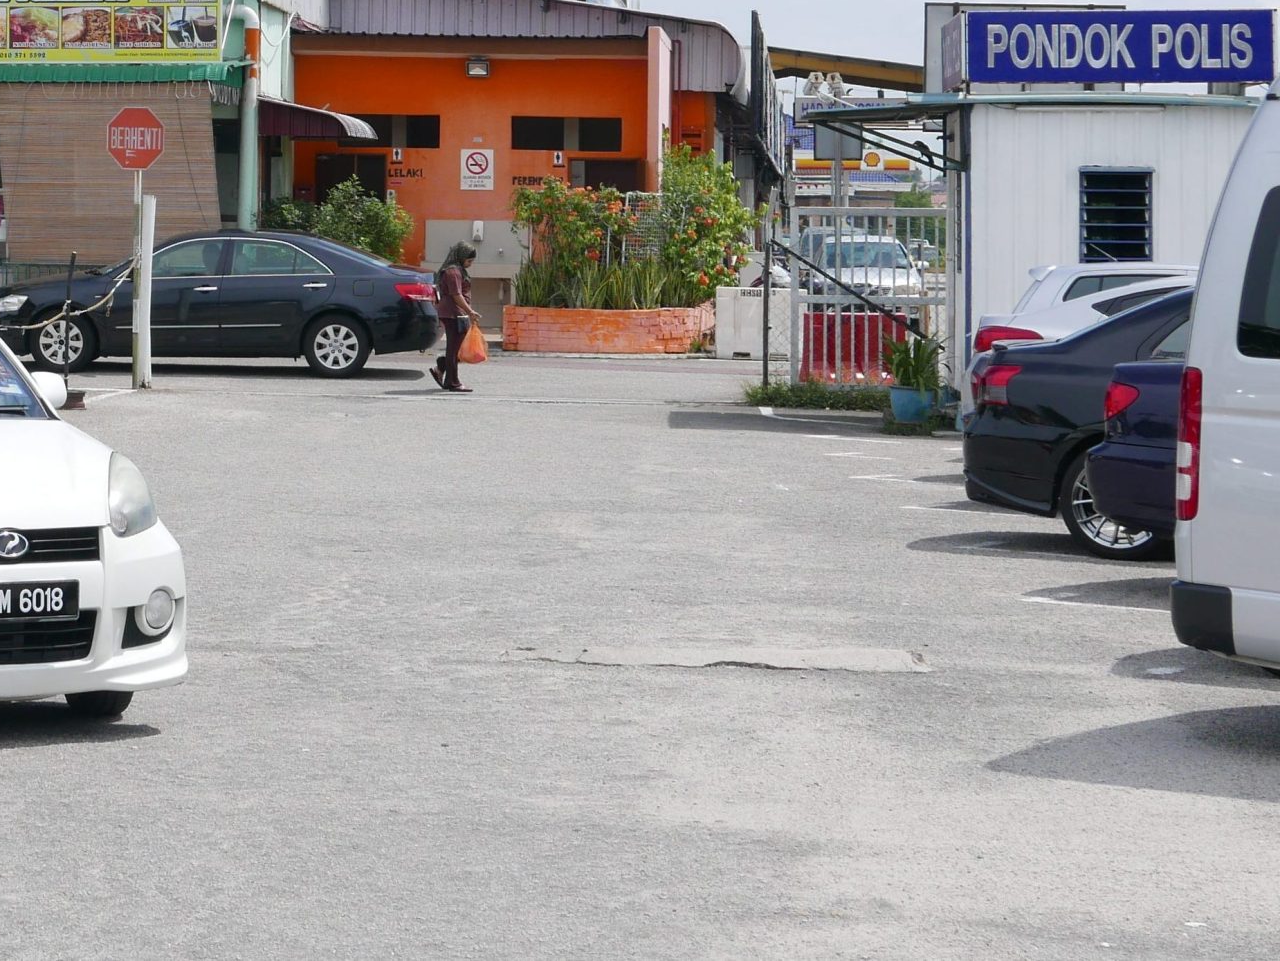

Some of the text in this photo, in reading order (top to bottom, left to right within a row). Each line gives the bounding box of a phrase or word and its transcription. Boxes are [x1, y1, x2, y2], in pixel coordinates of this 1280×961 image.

[986, 23, 1135, 69] PONDOK
[1151, 23, 1253, 69] POLIS
[111, 126, 161, 150] BERHENTI
[388, 168, 424, 178] LELAKI
[19, 587, 64, 613] 6018
